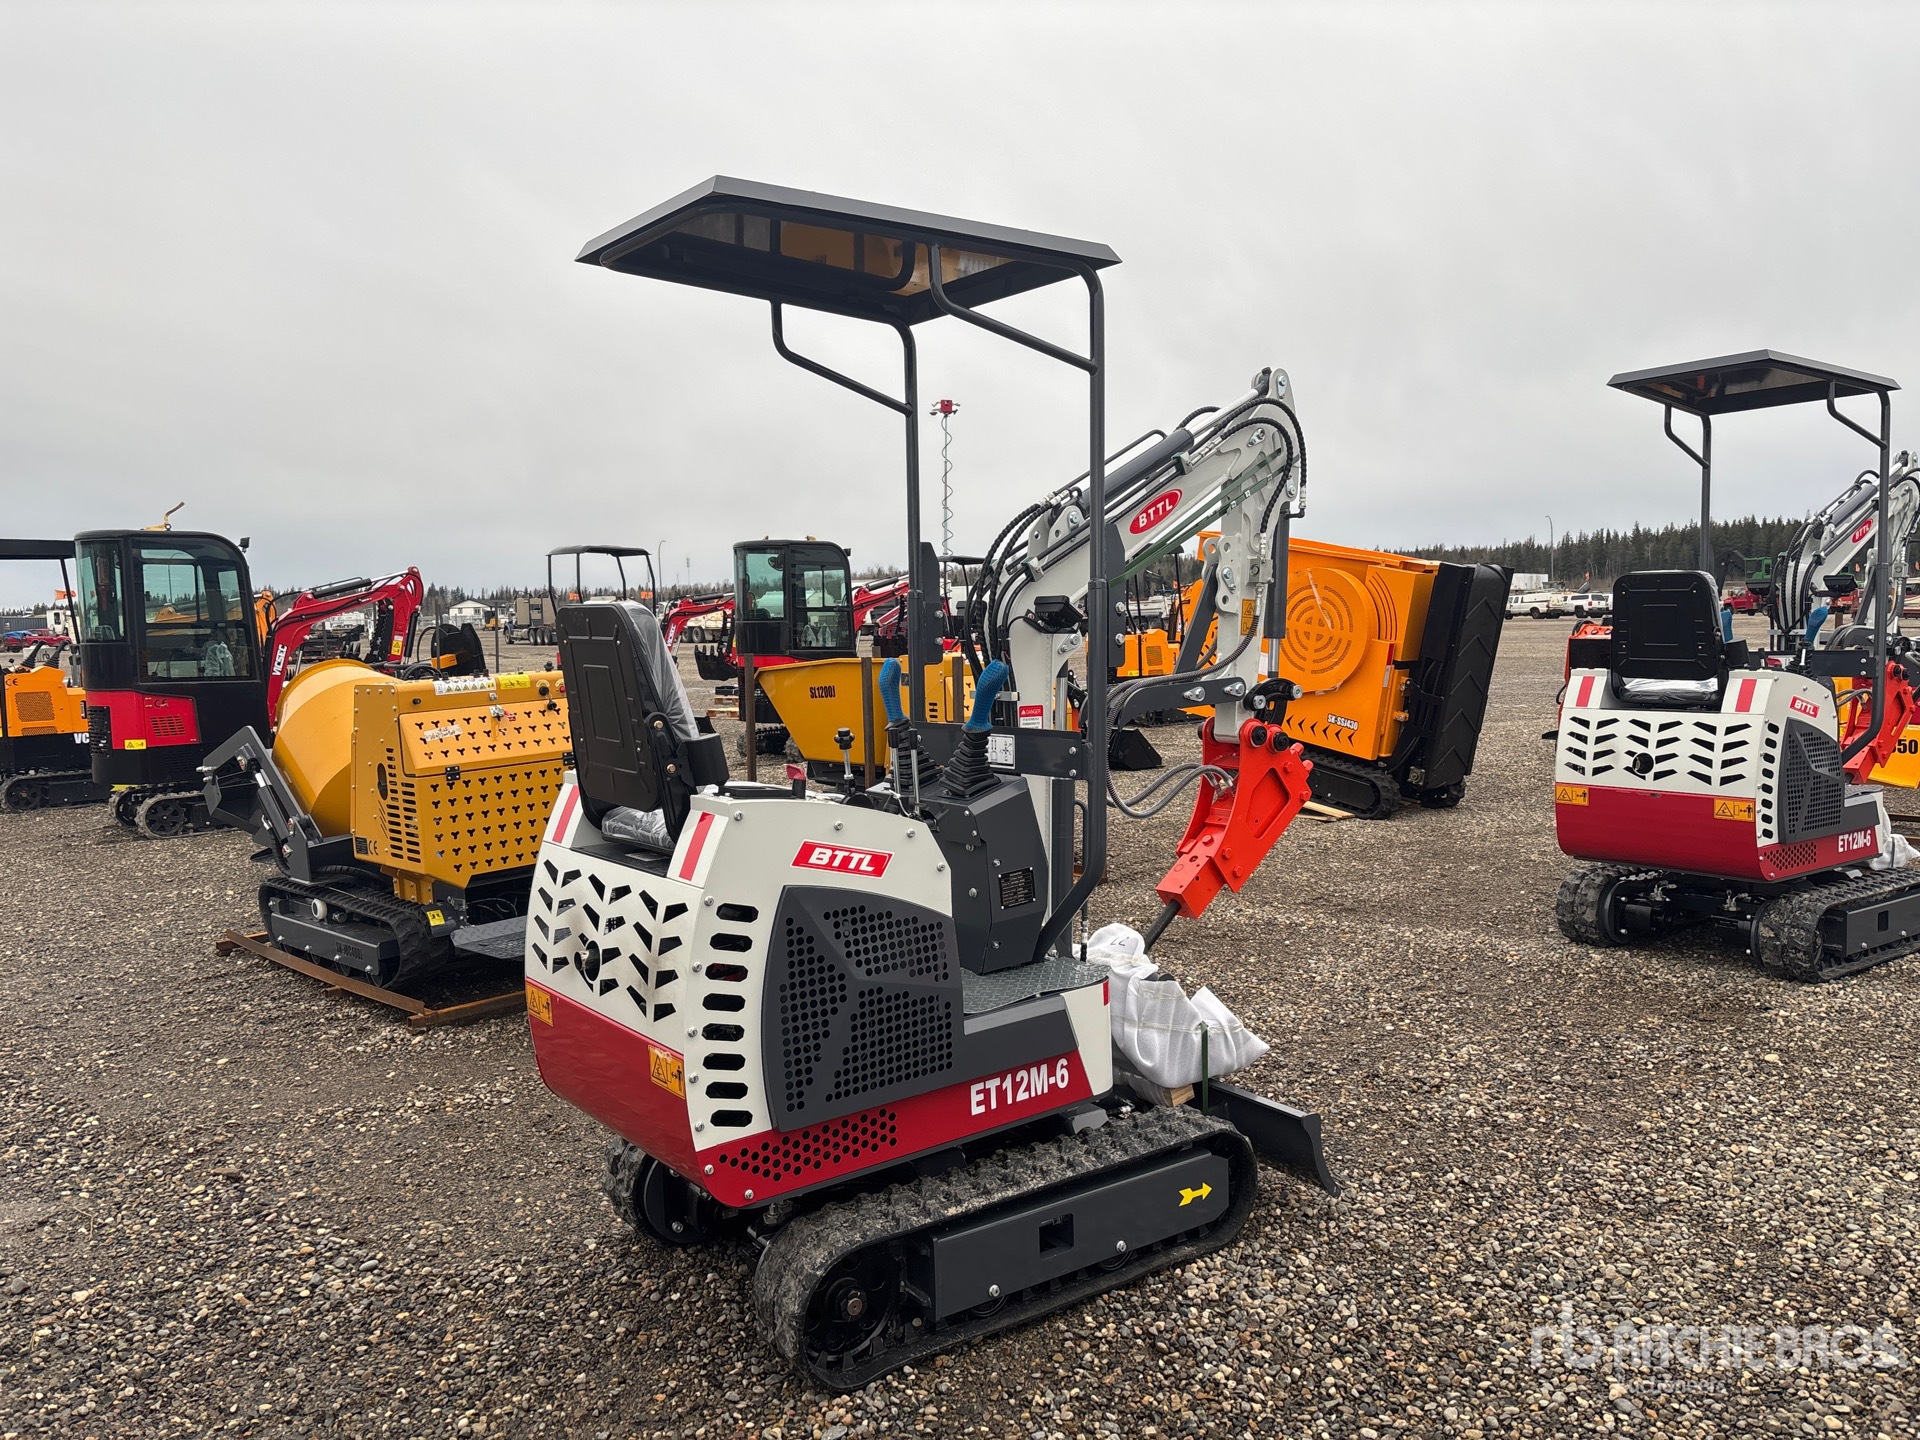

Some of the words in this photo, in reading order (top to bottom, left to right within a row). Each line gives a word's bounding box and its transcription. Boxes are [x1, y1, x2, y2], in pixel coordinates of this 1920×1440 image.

[1139, 498, 1173, 528] BTTL
[1855, 523, 1870, 540] BTTL
[272, 643, 288, 676] VICSEC
[1794, 699, 1816, 715] BTTL
[1838, 831, 1872, 853] ET12M-6
[808, 847, 876, 872] BTTL
[970, 1058, 1069, 1116] ET12M-6
